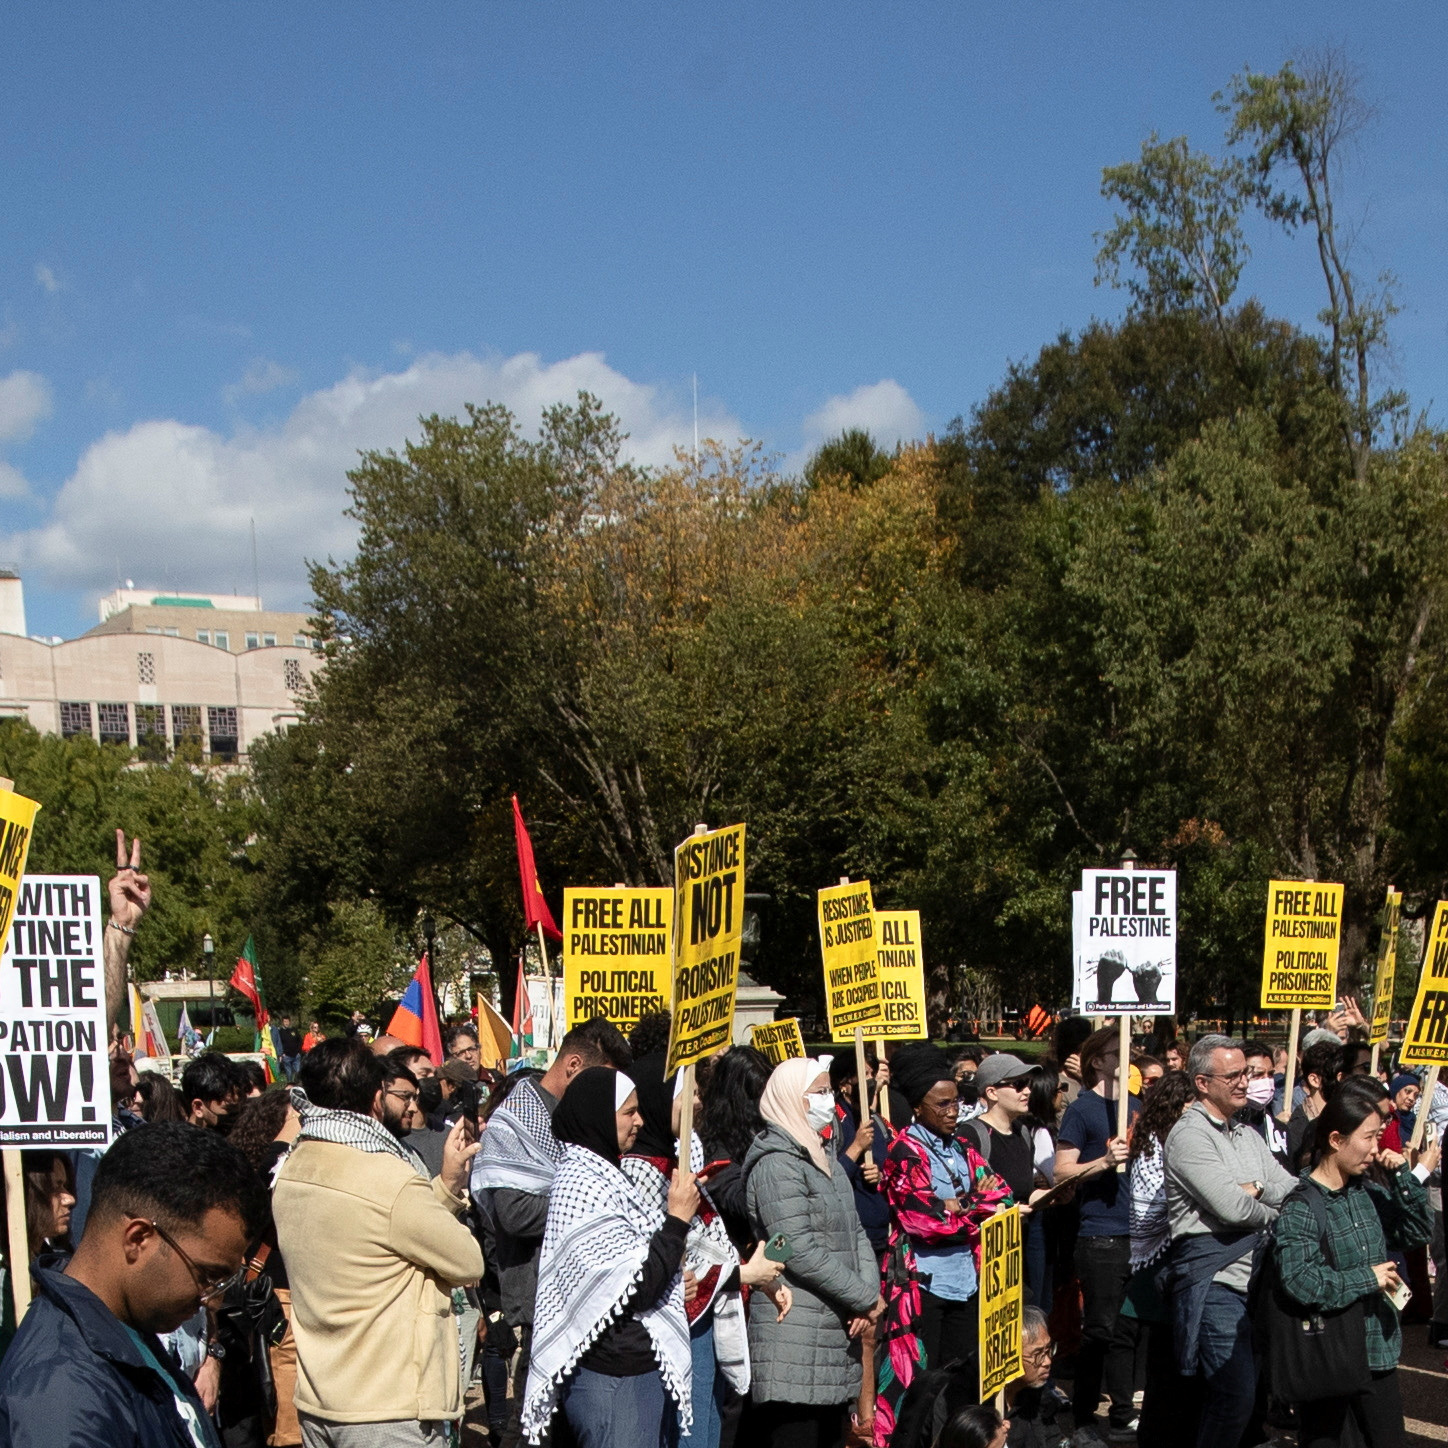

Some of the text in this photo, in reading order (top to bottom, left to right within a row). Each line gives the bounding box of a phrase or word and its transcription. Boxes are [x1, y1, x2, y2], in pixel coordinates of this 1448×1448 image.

[691, 872, 737, 945] NOT
[822, 891, 871, 923] RESISTANCE
[1095, 876, 1166, 915] FREE
[1275, 890, 1338, 918] FREE ALL
[572, 898, 624, 929] FREE
[629, 898, 666, 929] ALL
[1089, 917, 1172, 937] PALESTINE
[825, 917, 873, 948] IS JUSTIFIED
[882, 920, 915, 945] ALL
[1272, 919, 1337, 940] PALESTINIAN
[571, 933, 667, 956] PALESTINIAN
[829, 960, 877, 988] WHEN PEOPLE
[1276, 951, 1328, 970] POLITICAL
[13, 958, 98, 1008] THE
[580, 970, 658, 993] POLITICAL
[832, 987, 846, 1010] ARE
[846, 981, 880, 1005] OCCUPIED!
[1269, 972, 1332, 991] PRISONERS!
[680, 991, 733, 1034] PALESTINE!
[755, 1022, 798, 1047] PALESTINE
[784, 1040, 801, 1060] BE
[32, 1130, 52, 1141] and
[54, 1129, 105, 1141] Liberation
[985, 1213, 1020, 1264] END ALL
[985, 1250, 1020, 1302] U.S. AID
